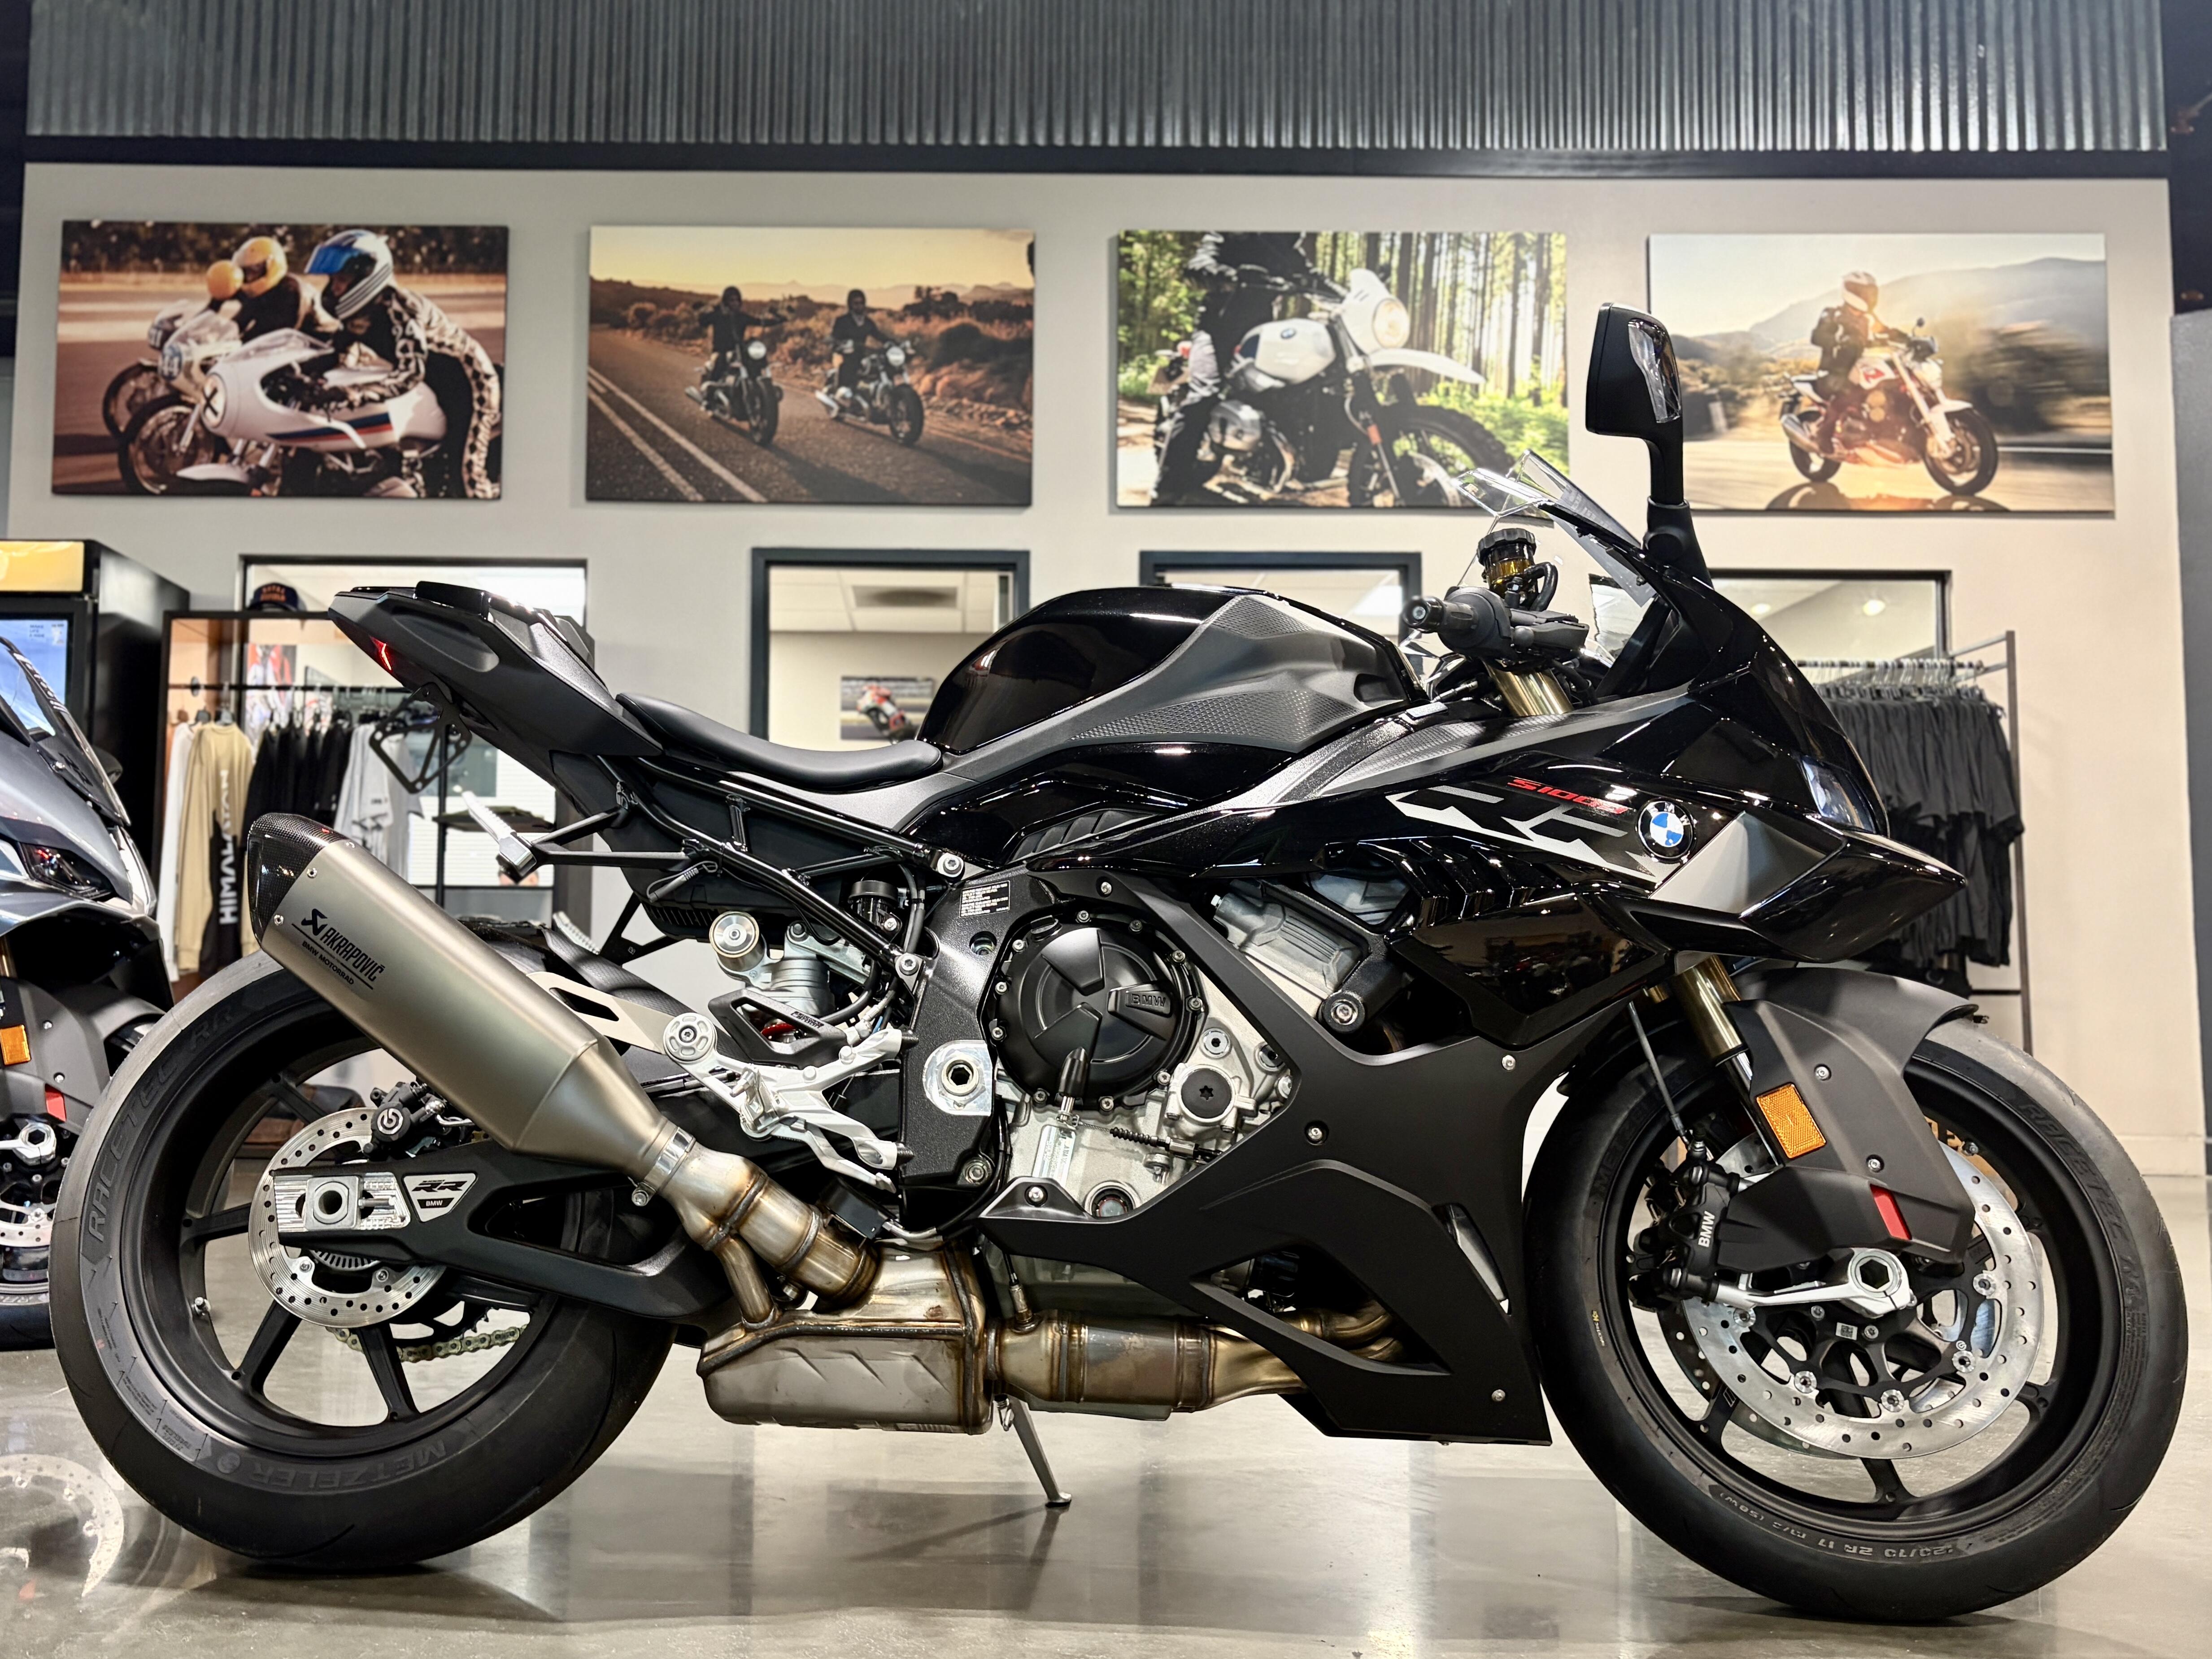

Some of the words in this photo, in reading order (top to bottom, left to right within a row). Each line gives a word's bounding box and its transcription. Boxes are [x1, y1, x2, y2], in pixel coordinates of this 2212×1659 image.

[302, 940, 319, 956] BMW
[318, 954, 354, 985] MOTORRAD
[1131, 993, 1166, 1007] BMW
[412, 1180, 467, 1192] RR
[1698, 1210, 1715, 1248] BMW
[253, 1439, 447, 1489] METZELER
[1817, 1537, 1834, 1549] 17
